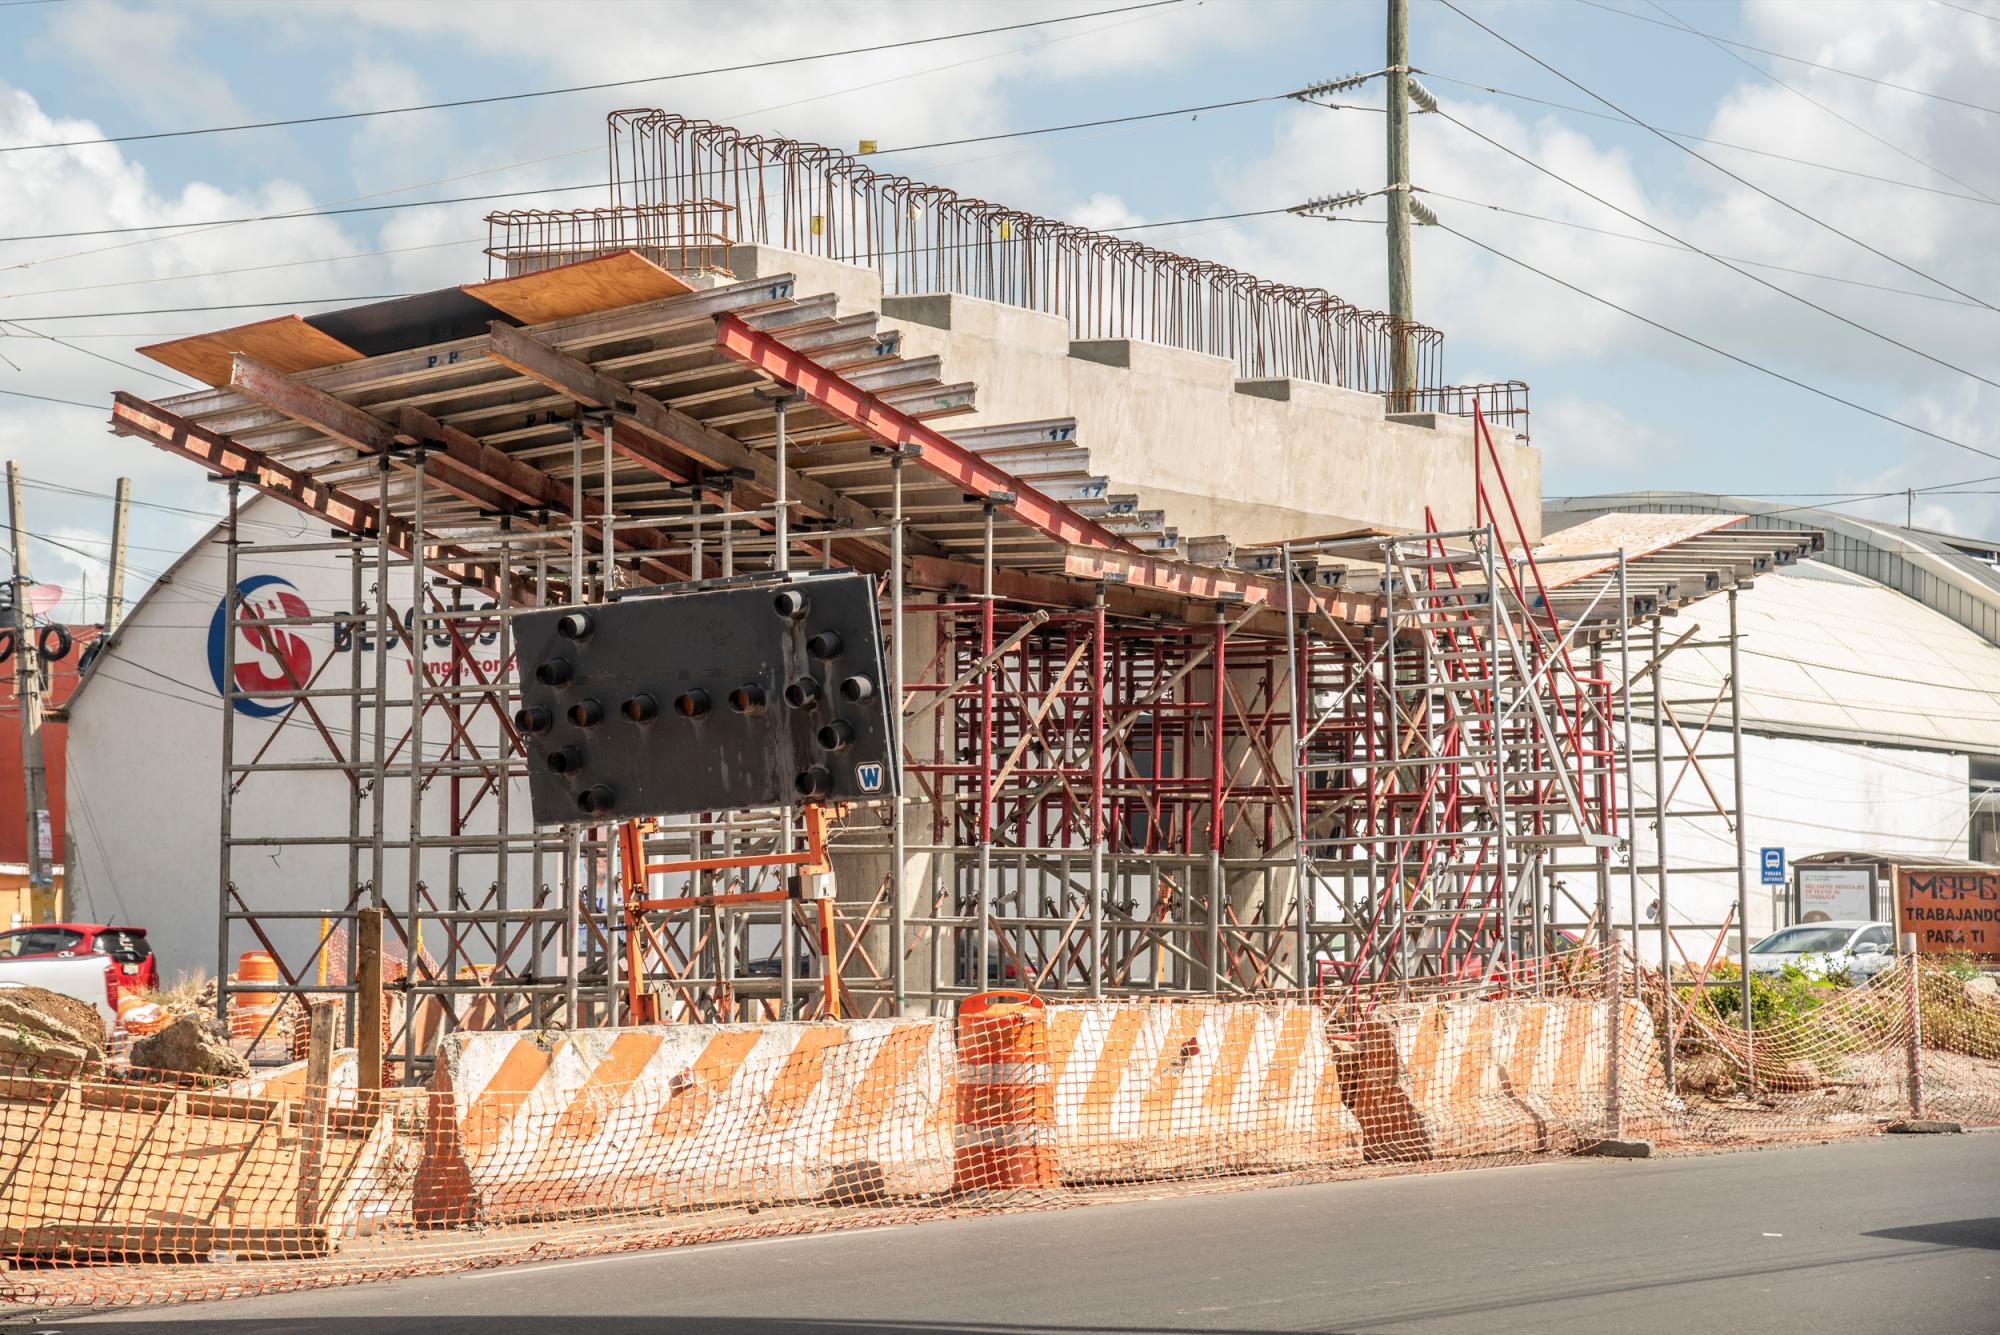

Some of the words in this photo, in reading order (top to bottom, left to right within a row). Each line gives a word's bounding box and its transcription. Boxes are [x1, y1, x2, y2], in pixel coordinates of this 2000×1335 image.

[769, 284, 788, 299] 17
[875, 341, 895, 355] 17
[1256, 556, 1274, 569] 17
[860, 767, 879, 787] W
[1906, 907, 2000, 921] TRABAJANDO
[1926, 929, 1965, 944] PARA
[1971, 929, 1985, 943] TI
